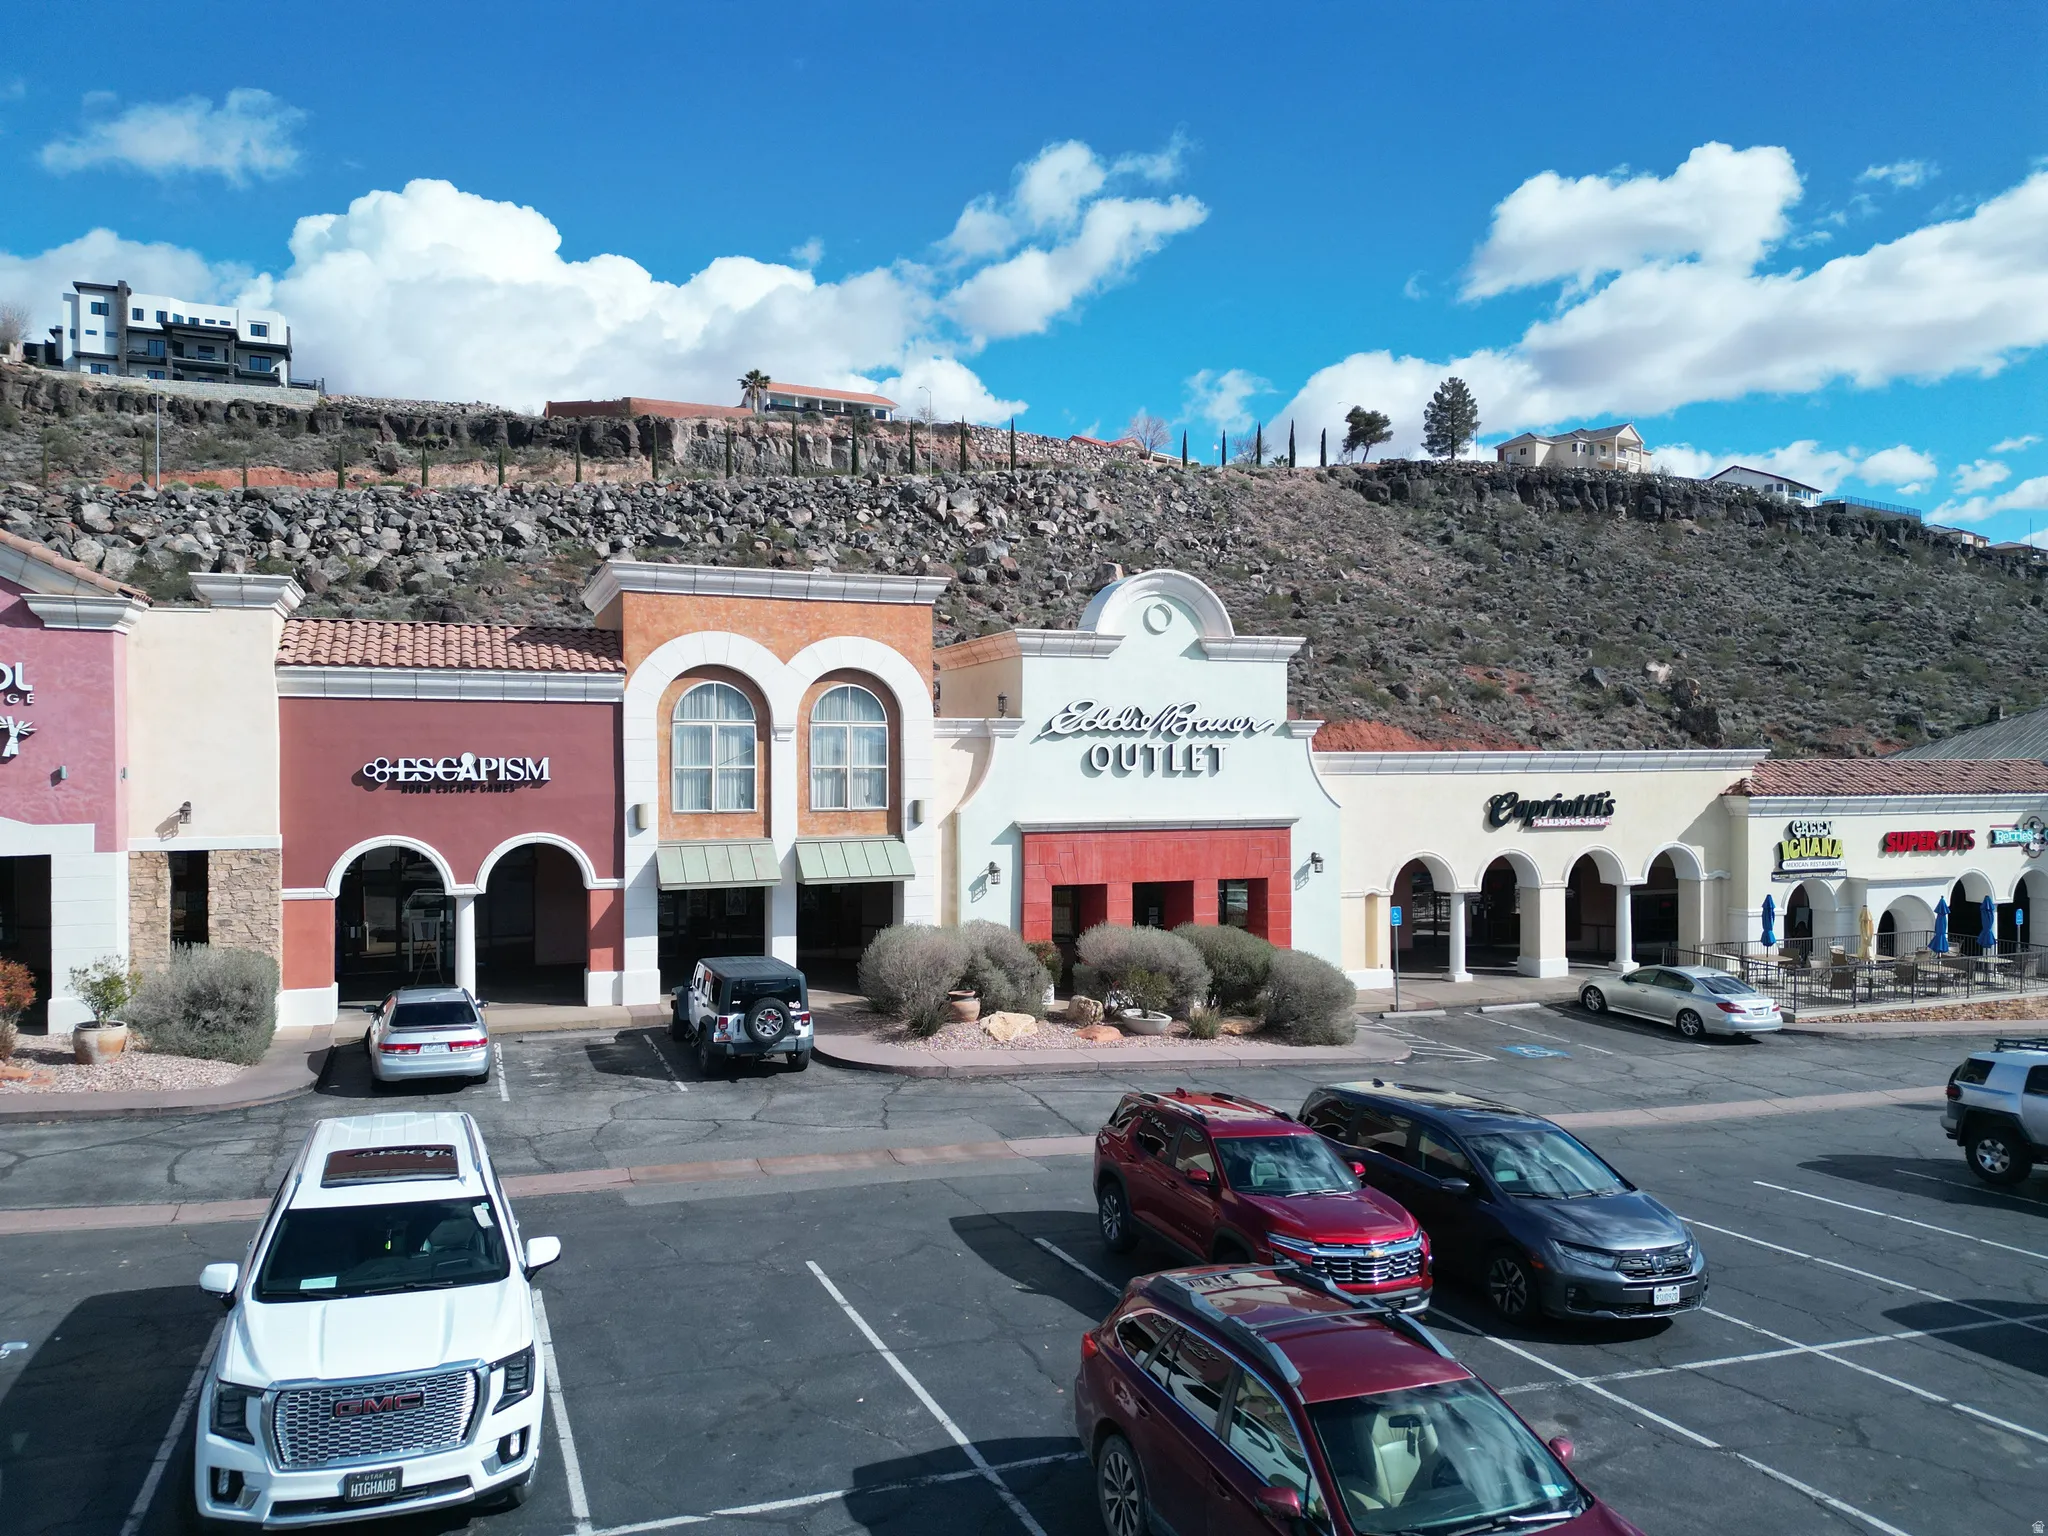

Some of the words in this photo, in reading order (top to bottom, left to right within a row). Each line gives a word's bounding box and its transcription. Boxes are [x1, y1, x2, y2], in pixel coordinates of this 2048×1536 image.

[1040, 698, 1153, 735] Eddie
[1151, 701, 1275, 736] Bauer
[396, 752, 551, 782] ESCAPISM
[1090, 743, 1230, 772] OUTLET
[401, 784, 431, 794] ROOM
[435, 783, 476, 794] ESCAPE
[480, 782, 516, 793] GAMES
[1489, 790, 1616, 828] Capriotti's
[1791, 820, 1835, 838] GREEN
[1886, 829, 1976, 853] SUPERCUTS
[1782, 837, 1844, 860] IGUANA
[335, 1392, 421, 1417] GMC
[350, 1478, 397, 1498] HIGHAUB
[364, 1473, 384, 1481] UTAH
